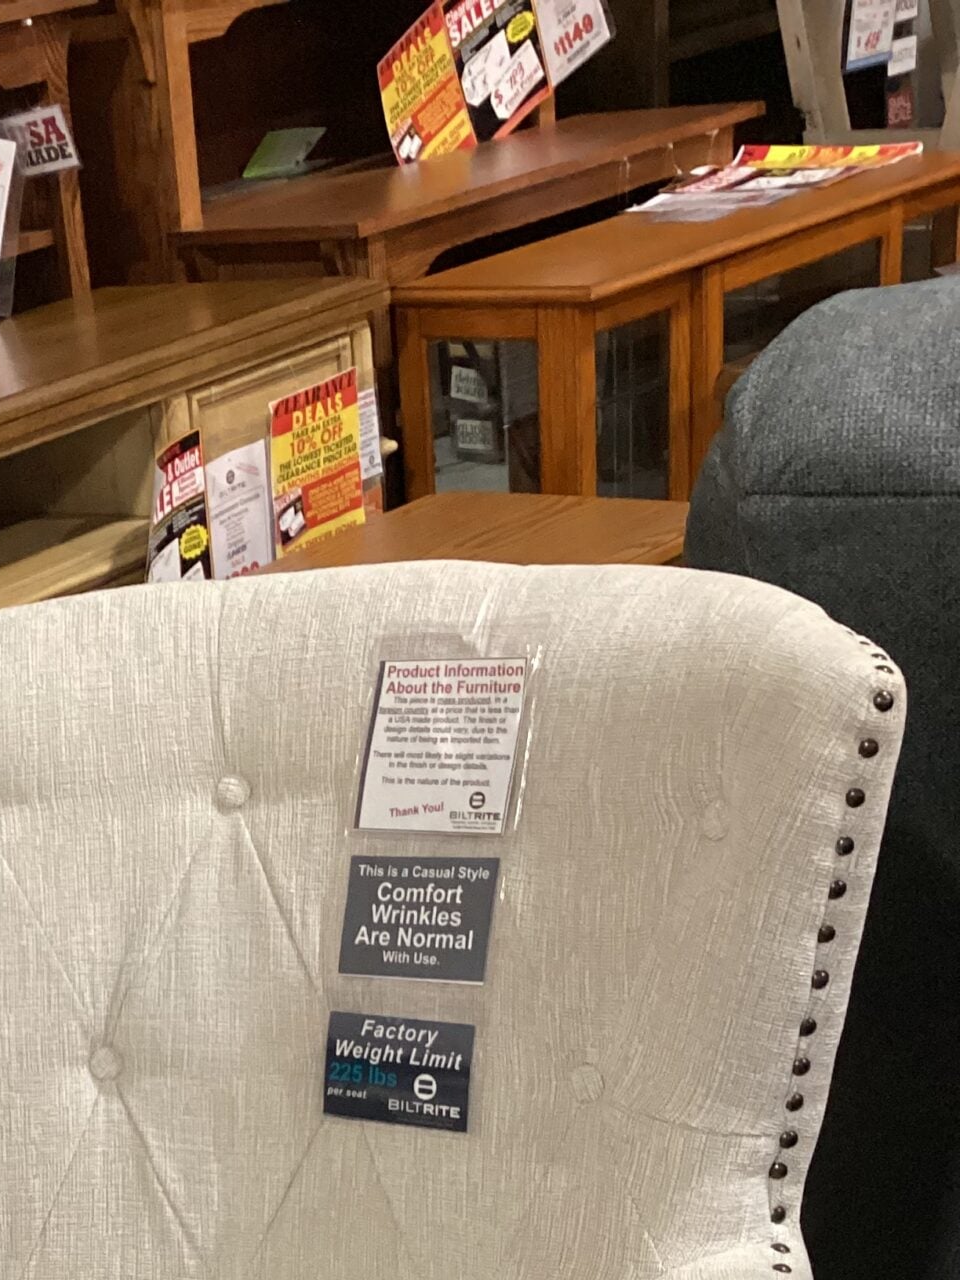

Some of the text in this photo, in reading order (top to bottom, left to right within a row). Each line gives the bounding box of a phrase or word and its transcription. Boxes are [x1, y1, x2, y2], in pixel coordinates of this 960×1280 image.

[292, 392, 344, 429] DEALS
[320, 421, 344, 445] OFF
[387, 663, 524, 679] Product Information
[386, 680, 521, 694] About the Furniture
[389, 802, 444, 818] Thank You!
[449, 811, 501, 821] BILTRITE
[358, 864, 490, 882] This is a Casual Style
[377, 882, 463, 904] Comfort
[371, 904, 462, 927] Wrinkles
[355, 926, 474, 950] Are Normal
[382, 950, 440, 966] With Use.
[360, 1019, 439, 1047] Factory
[335, 1040, 463, 1071] Weight Limit
[329, 1062, 398, 1088] 225 lbs
[327, 1087, 367, 1100] per seat
[388, 1099, 461, 1119] BILTRITE
